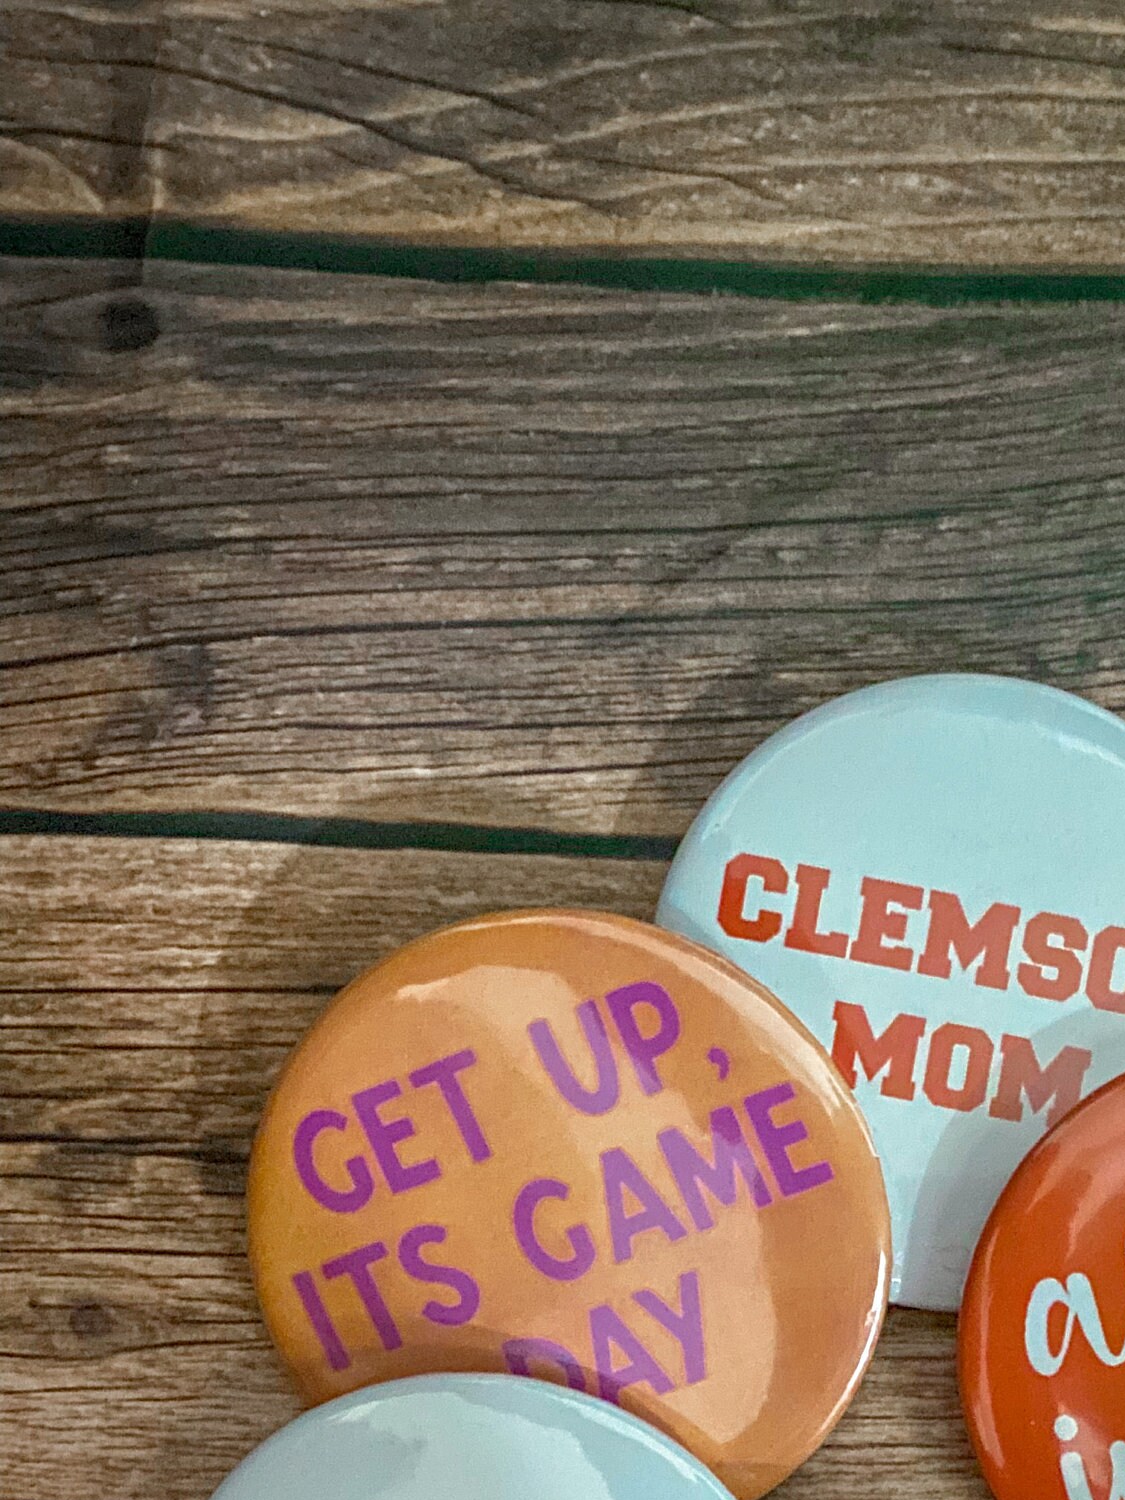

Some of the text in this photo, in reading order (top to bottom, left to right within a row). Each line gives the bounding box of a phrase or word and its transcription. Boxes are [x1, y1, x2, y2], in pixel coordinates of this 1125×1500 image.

[292, 1048, 493, 1214] GET
[830, 999, 1093, 1131] MOM
[291, 1081, 836, 1373] ITS GAME
